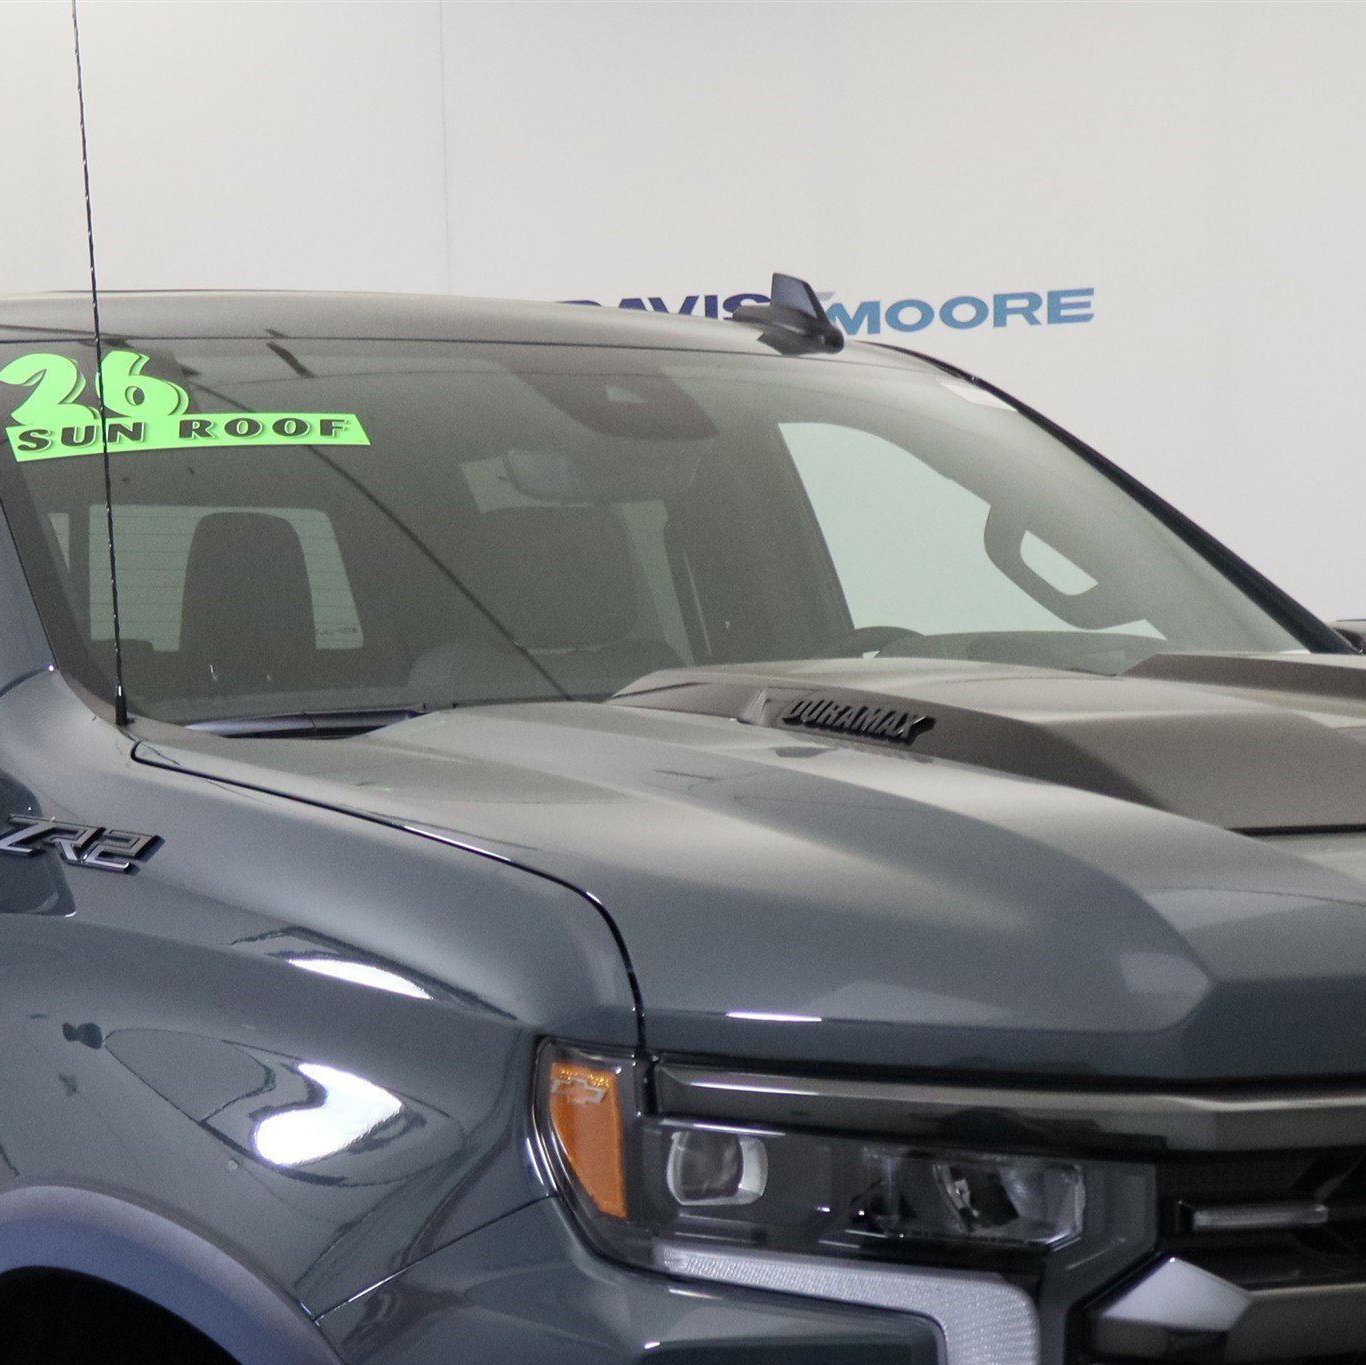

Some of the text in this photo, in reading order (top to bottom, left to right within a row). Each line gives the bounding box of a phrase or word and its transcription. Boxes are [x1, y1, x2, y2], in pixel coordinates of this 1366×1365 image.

[556, 287, 1095, 336] VIS MOORE
[17, 417, 351, 452] SUN ROOF
[783, 699, 932, 744] DURAMAX
